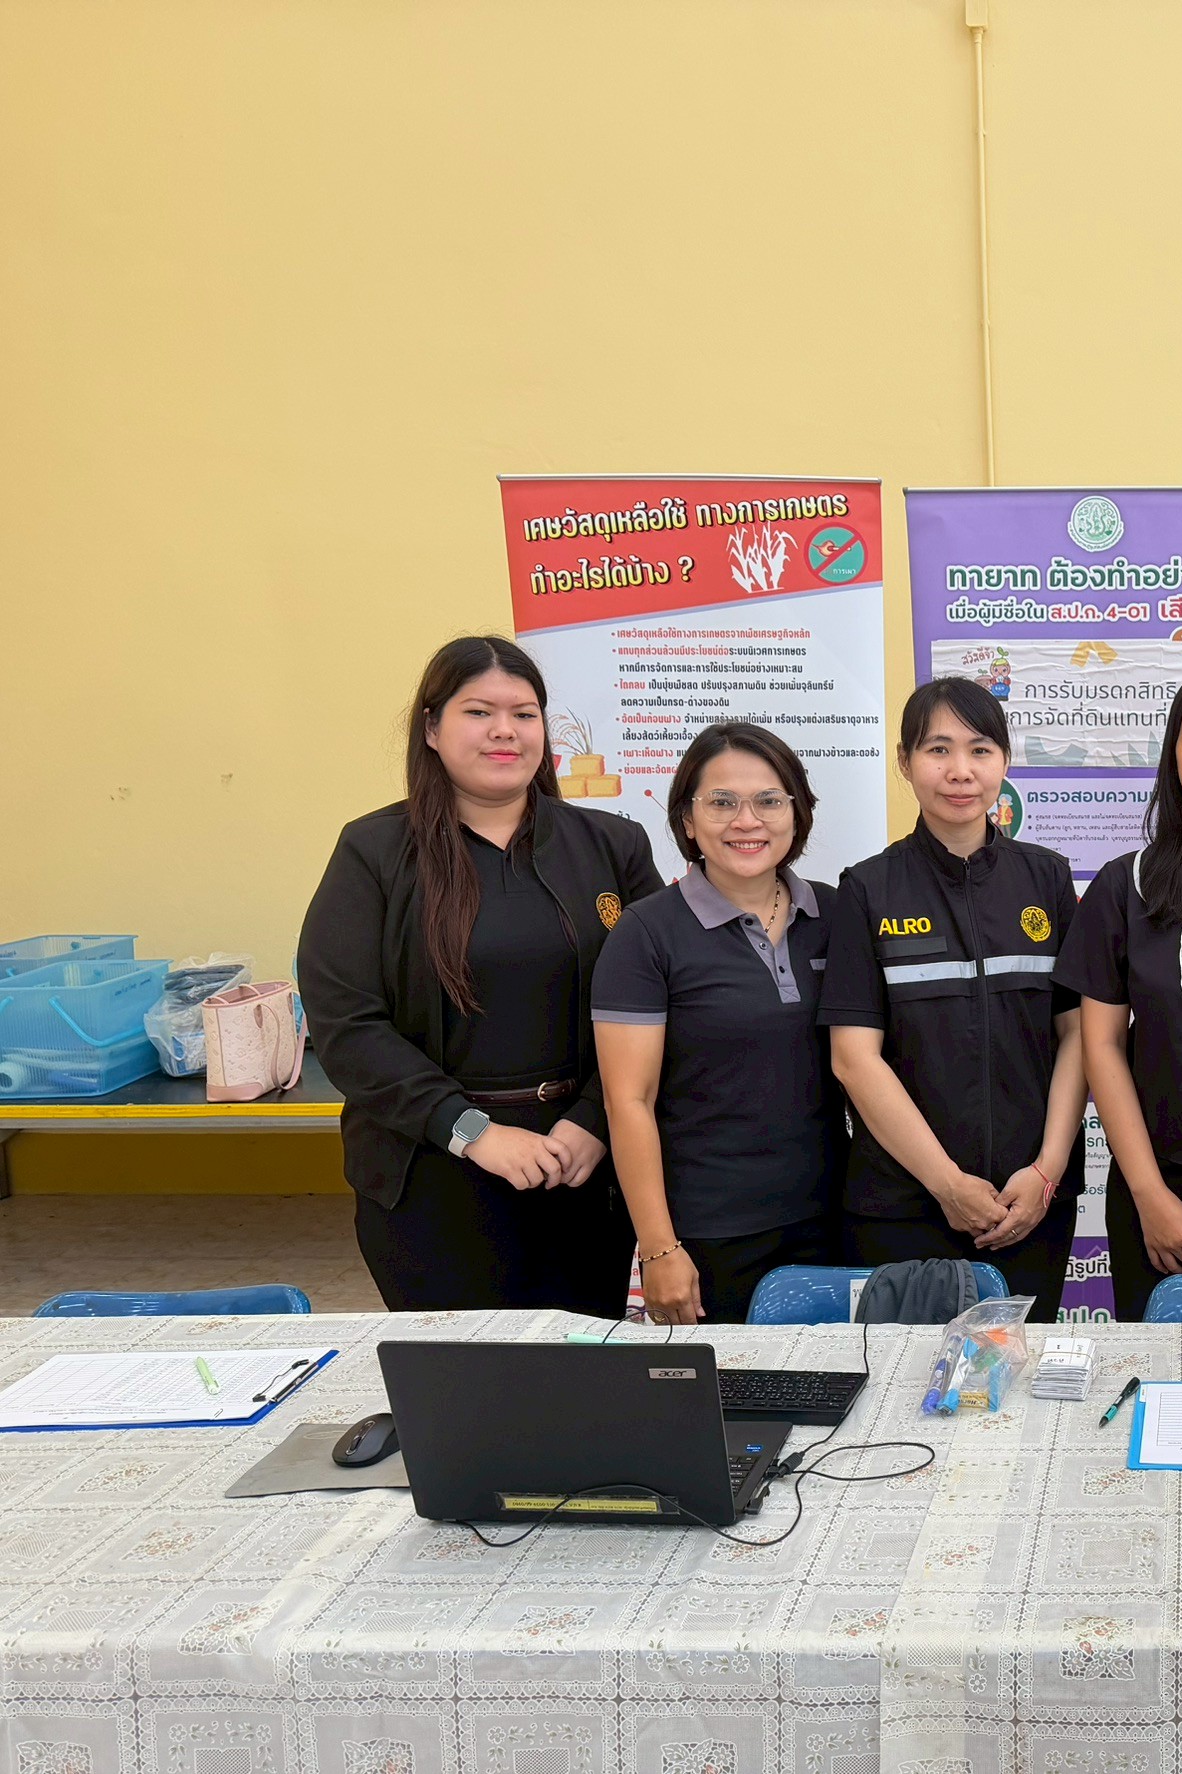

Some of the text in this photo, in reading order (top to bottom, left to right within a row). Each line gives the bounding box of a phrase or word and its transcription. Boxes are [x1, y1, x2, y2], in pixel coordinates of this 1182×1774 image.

[523, 492, 849, 543] เศษวัสดุเหลือใช้ ทางการเกษตร
[530, 554, 695, 596] ทำอะไรได้บ้าง ?
[948, 565, 1038, 590] ทายาท
[948, 599, 1045, 626] เมื่อผู้มีชื่อใน
[1050, 602, 1102, 621] ส.ป.ก.
[1106, 603, 1149, 621] 4-01
[878, 916, 932, 936] ALRO
[658, 1370, 687, 1378] acer
